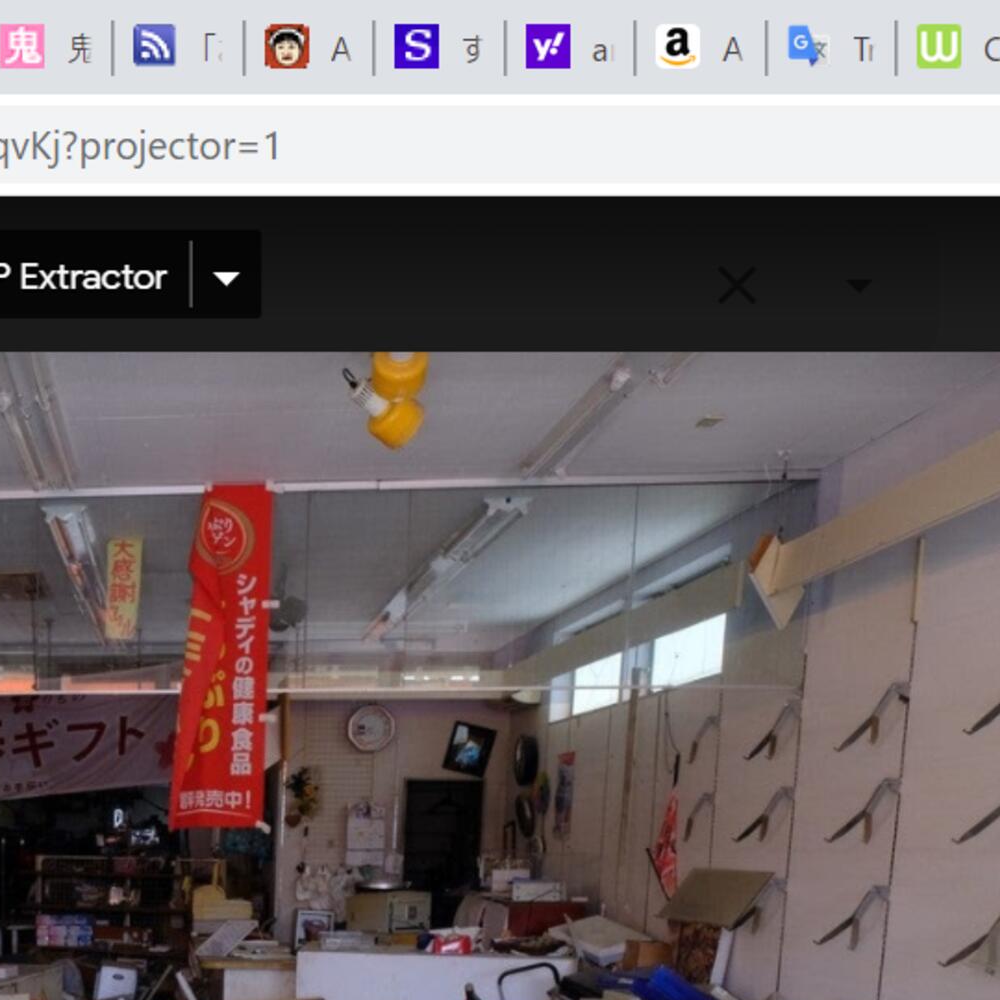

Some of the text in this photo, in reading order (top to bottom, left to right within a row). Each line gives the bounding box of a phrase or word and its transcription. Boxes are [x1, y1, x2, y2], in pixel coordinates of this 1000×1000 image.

[4, 27, 41, 63] 鬼
[331, 36, 352, 62] A
[404, 29, 432, 61] S
[721, 36, 743, 62] A
[20, 262, 168, 290] Extractor
